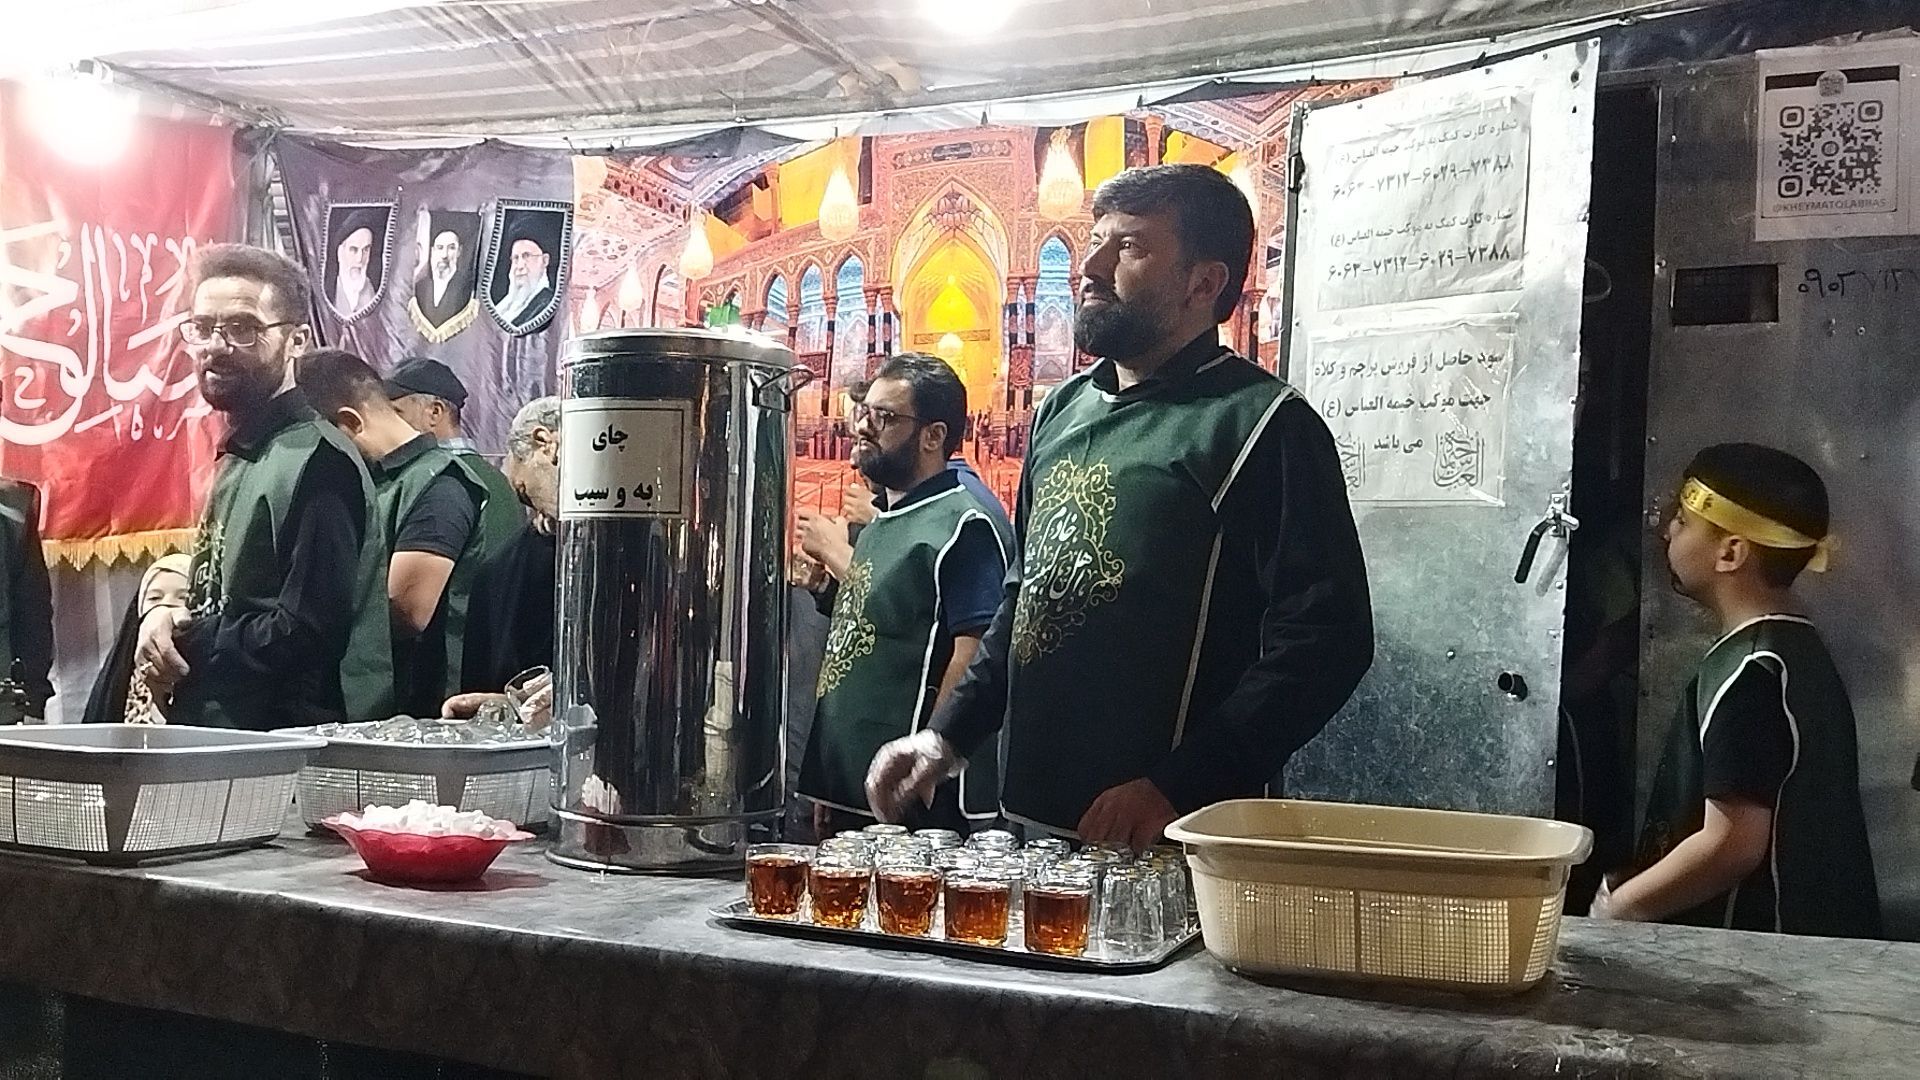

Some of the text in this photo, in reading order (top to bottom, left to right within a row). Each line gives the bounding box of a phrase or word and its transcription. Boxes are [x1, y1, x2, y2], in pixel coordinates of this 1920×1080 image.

[1463, 124, 1486, 140] کارت
[1436, 216, 1457, 229] کمک
[1460, 212, 1483, 229] کارت
[1314, 349, 1505, 380] سود حاصل از فروش پرچم و کلاه
[1321, 392, 1491, 418] جهت موکب خیمه العباس (ع)
[593, 424, 628, 452] چای
[1373, 434, 1423, 453] می باشد
[574, 483, 653, 508] به و سیب
[1037, 506, 1077, 560] خادم
